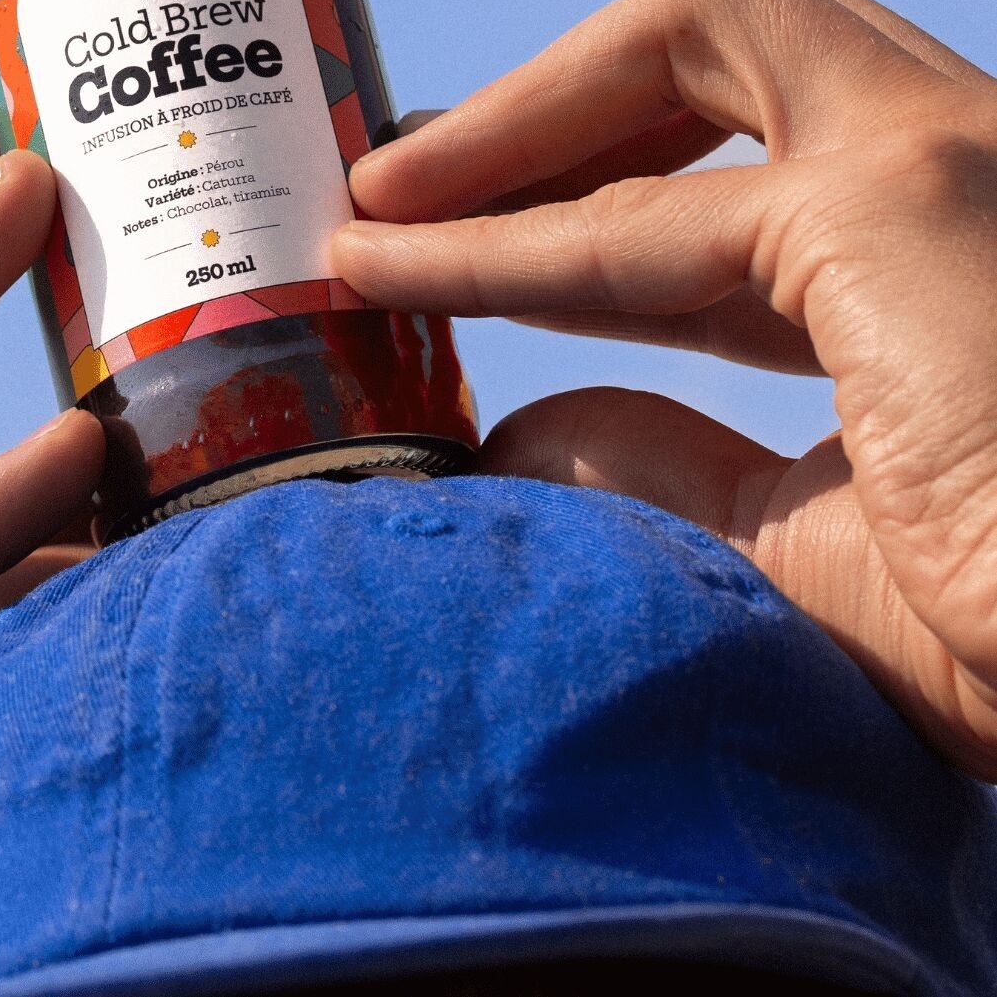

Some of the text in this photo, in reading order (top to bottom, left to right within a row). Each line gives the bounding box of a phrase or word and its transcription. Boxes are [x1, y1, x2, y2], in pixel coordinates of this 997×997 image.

[64, 8, 157, 68] Cold
[68, 33, 283, 124] Coffee
[82, 87, 293, 155] INFUSION À FROID DE CAFÉ
[202, 174, 256, 192] Caturra
[205, 157, 245, 174] Pérou
[166, 194, 232, 220] Chocolat,
[233, 184, 291, 203] tiramisu
[185, 254, 257, 287] 250 ml
